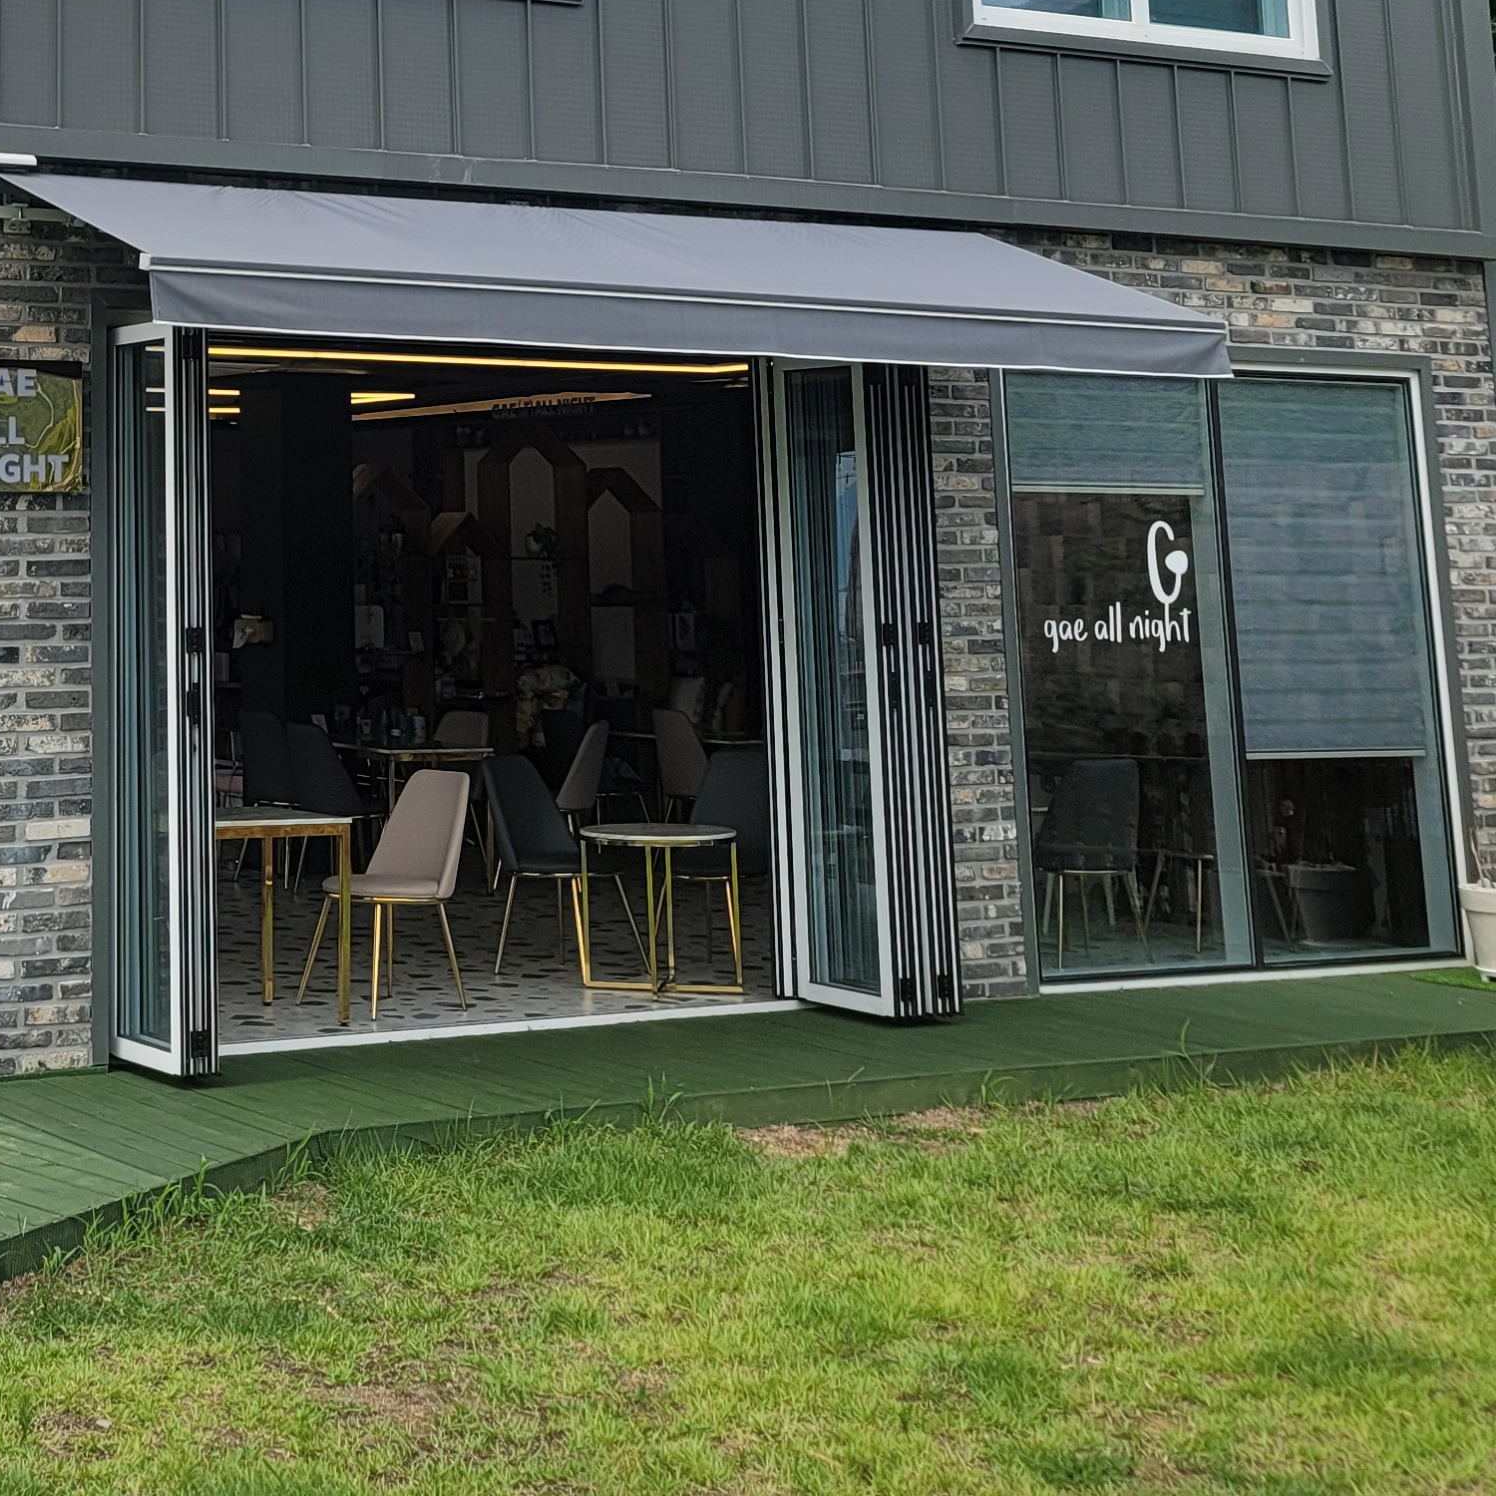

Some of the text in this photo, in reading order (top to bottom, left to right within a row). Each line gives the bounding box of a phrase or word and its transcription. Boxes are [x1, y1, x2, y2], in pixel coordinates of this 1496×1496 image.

[1044, 601, 1191, 653] gae all night
